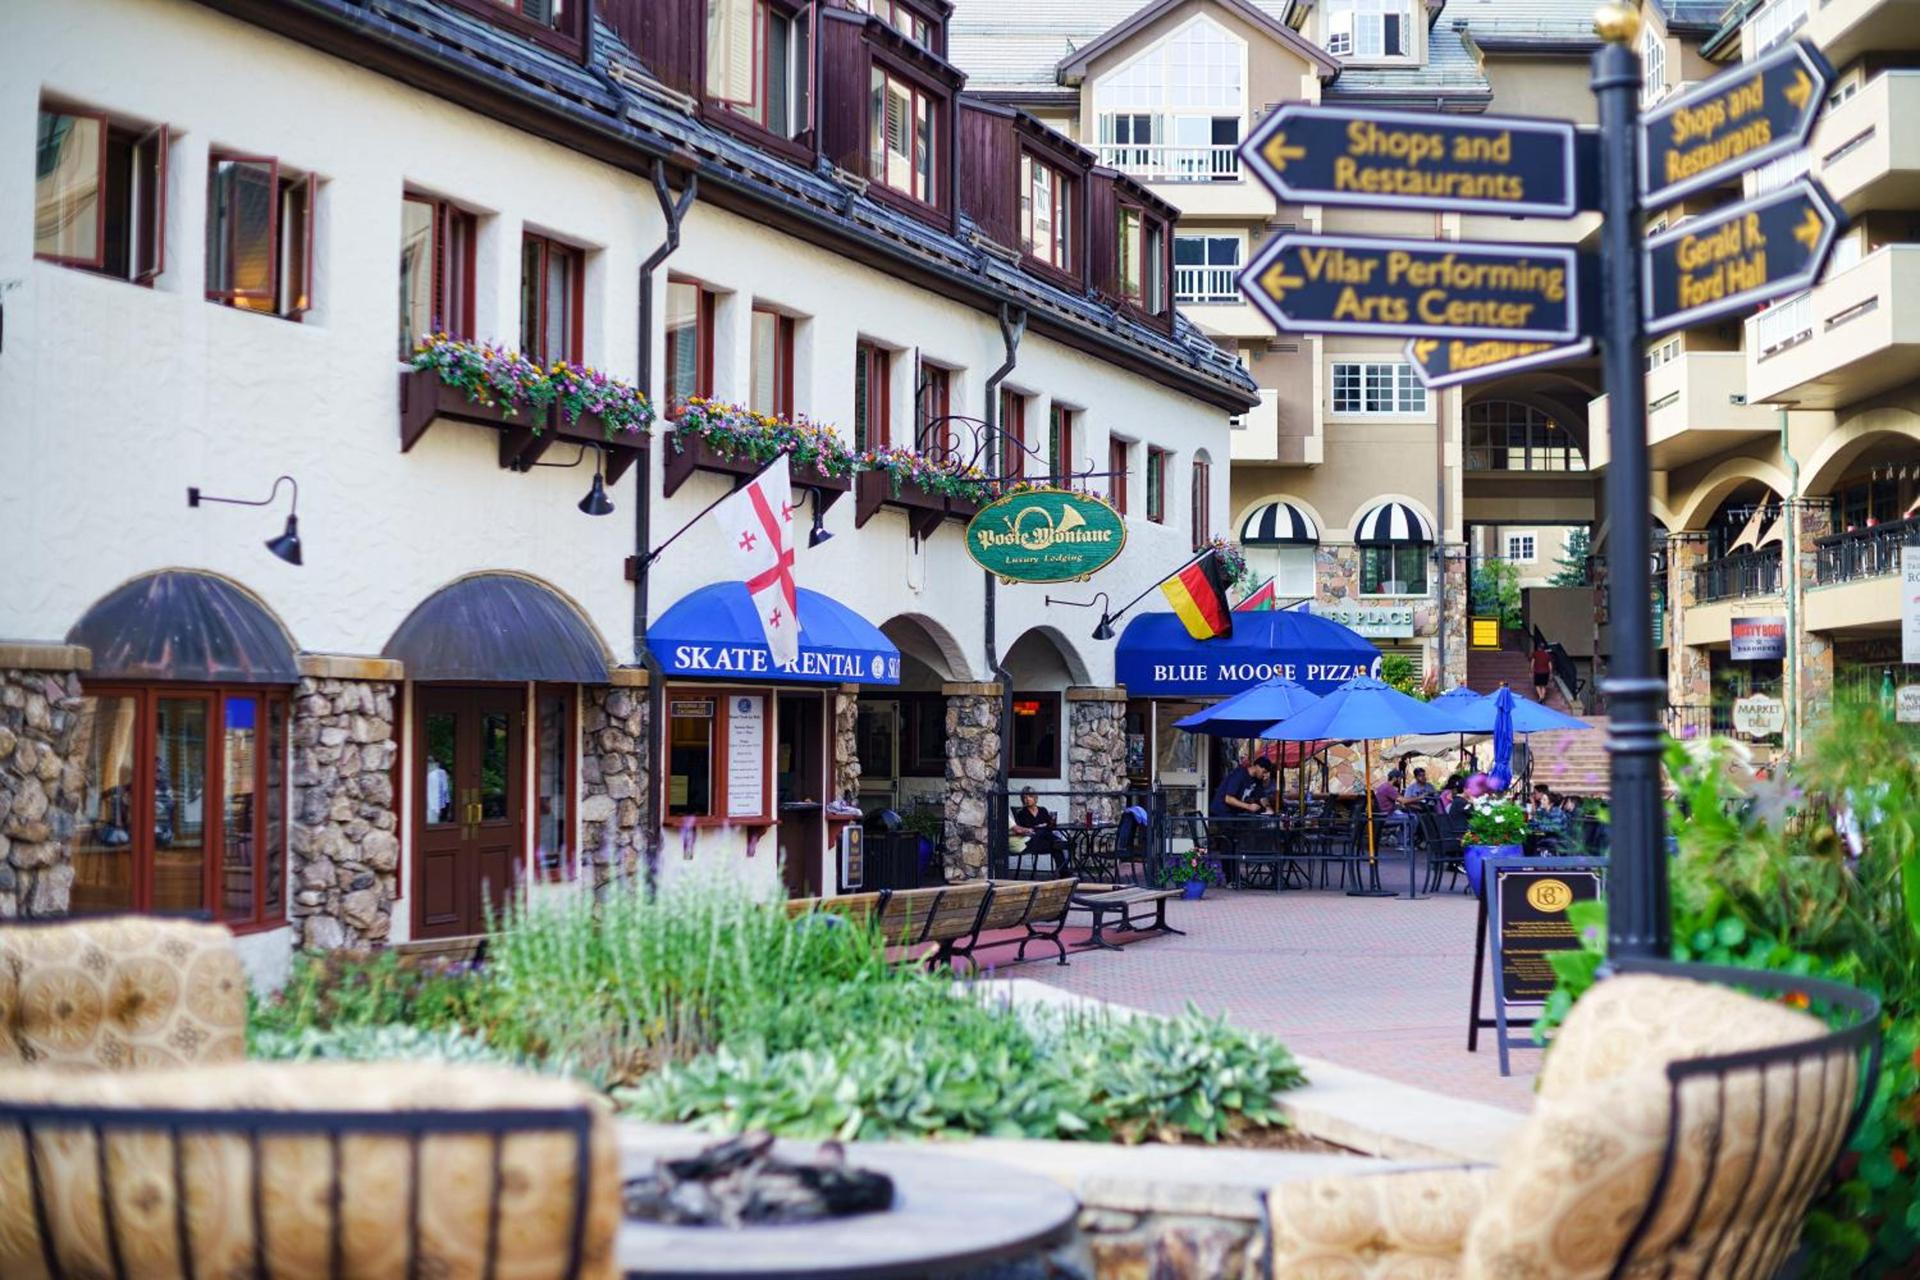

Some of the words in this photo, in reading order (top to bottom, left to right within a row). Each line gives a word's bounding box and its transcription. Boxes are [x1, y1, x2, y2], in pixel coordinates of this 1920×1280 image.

[1671, 100, 1725, 145] Shops
[1728, 72, 1764, 121] and
[1347, 119, 1444, 167] Shops
[1452, 130, 1511, 164] and
[1665, 119, 1772, 184] Restaurants
[1334, 155, 1523, 200] Restaurants
[1676, 219, 1742, 272] Gerald
[1744, 211, 1767, 248] R.
[1299, 246, 1379, 284] Vilar
[1387, 251, 1565, 302] Performing
[1679, 262, 1725, 309] Ford
[1727, 250, 1768, 294] Hall
[1333, 287, 1409, 323] Arts
[1417, 289, 1535, 327] Center
[1032, 527, 1112, 547] Montane
[1005, 555, 1039, 565] Luxury
[1044, 553, 1084, 565] Lodging
[1356, 611, 1413, 626] PLACE
[674, 645, 768, 672] SKATE
[783, 650, 865, 678] RENTAL
[1153, 664, 1208, 682] BLUE
[1737, 704, 1779, 714] MARKET
[1748, 718, 1771, 728] DELI
